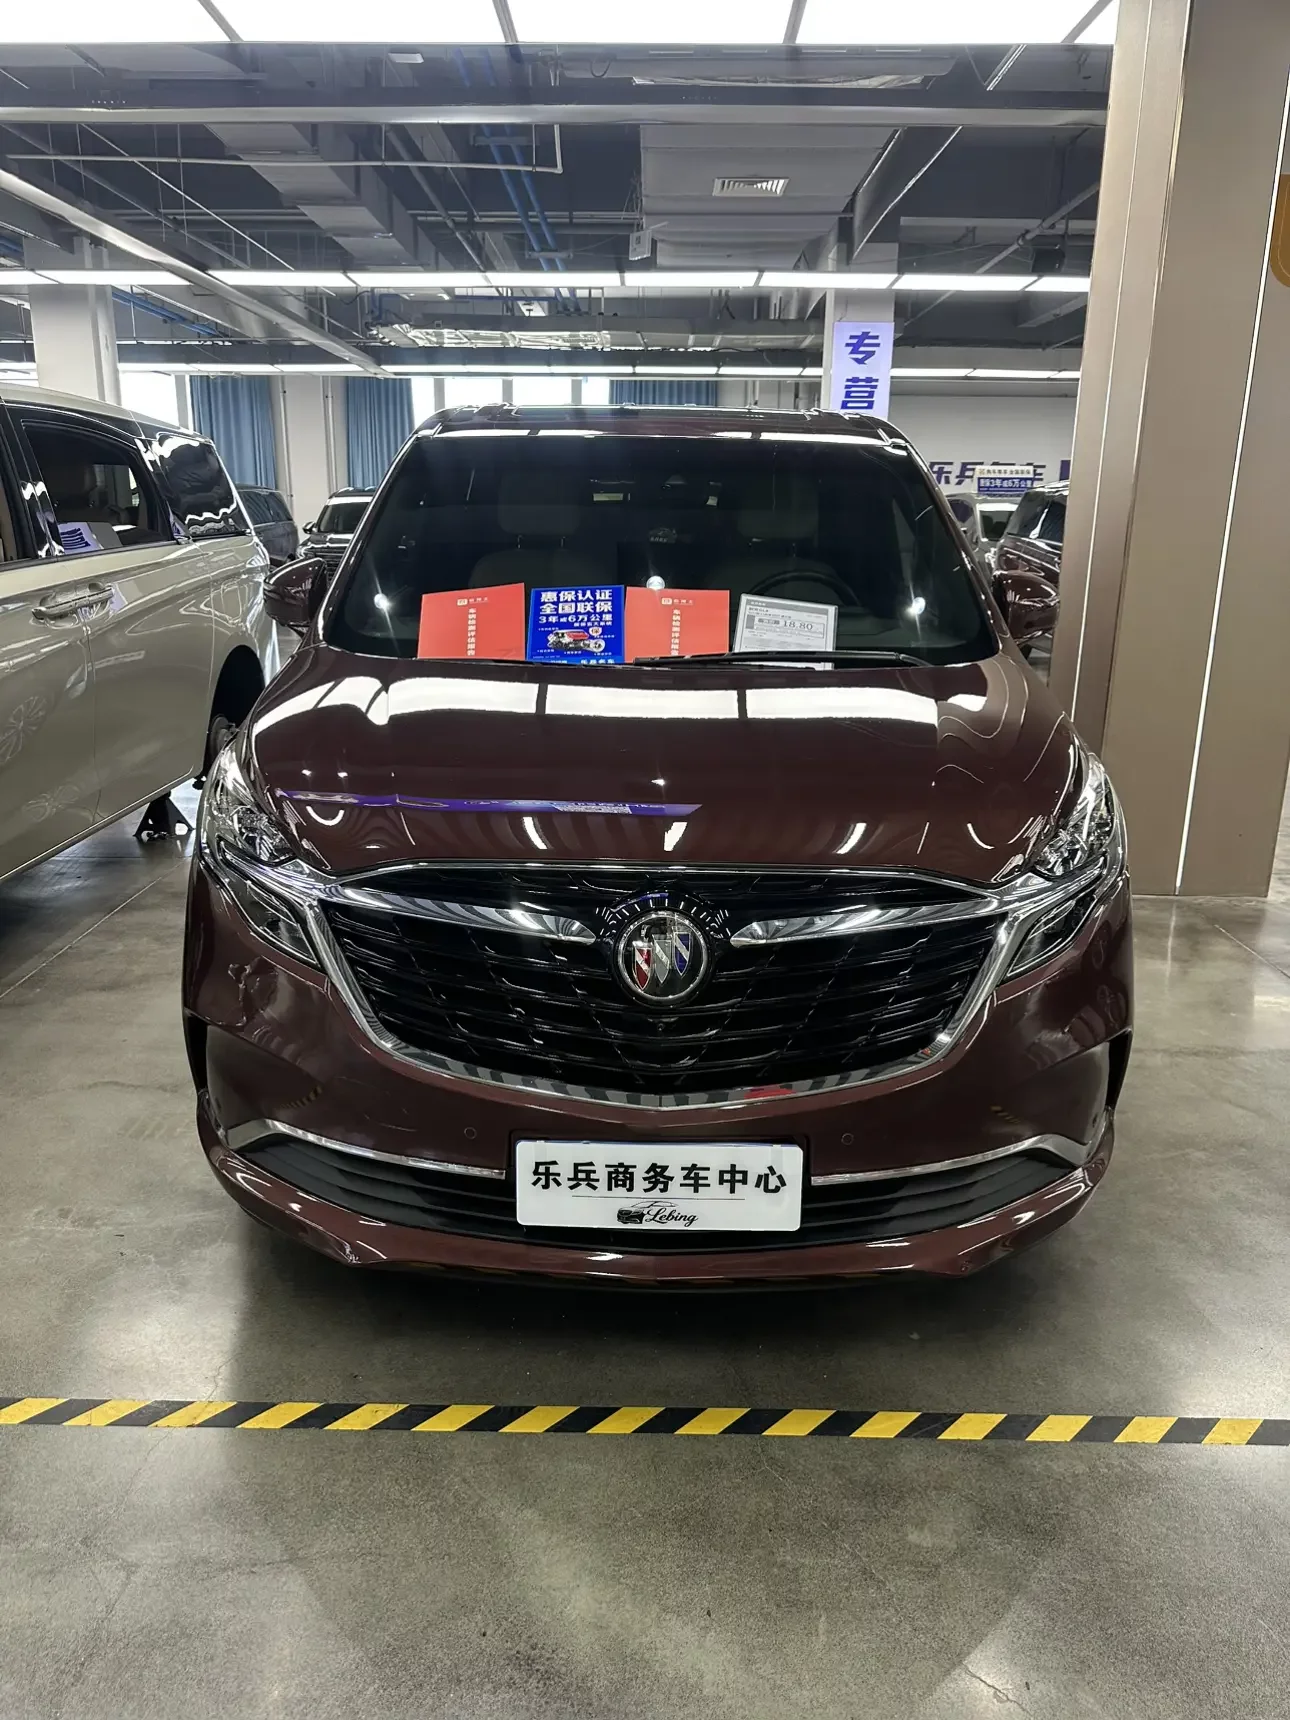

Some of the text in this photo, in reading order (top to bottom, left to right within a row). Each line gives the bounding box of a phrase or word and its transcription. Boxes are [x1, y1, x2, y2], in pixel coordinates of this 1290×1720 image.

[840, 331, 881, 410] 专营
[540, 589, 613, 603] 惠保认证
[540, 601, 613, 615] 全国联保
[539, 613, 613, 624] 3年或6万公里
[783, 620, 813, 631] 18.80
[531, 1160, 787, 1195] 乐兵商务车中心
[645, 1207, 699, 1228] Lebing
